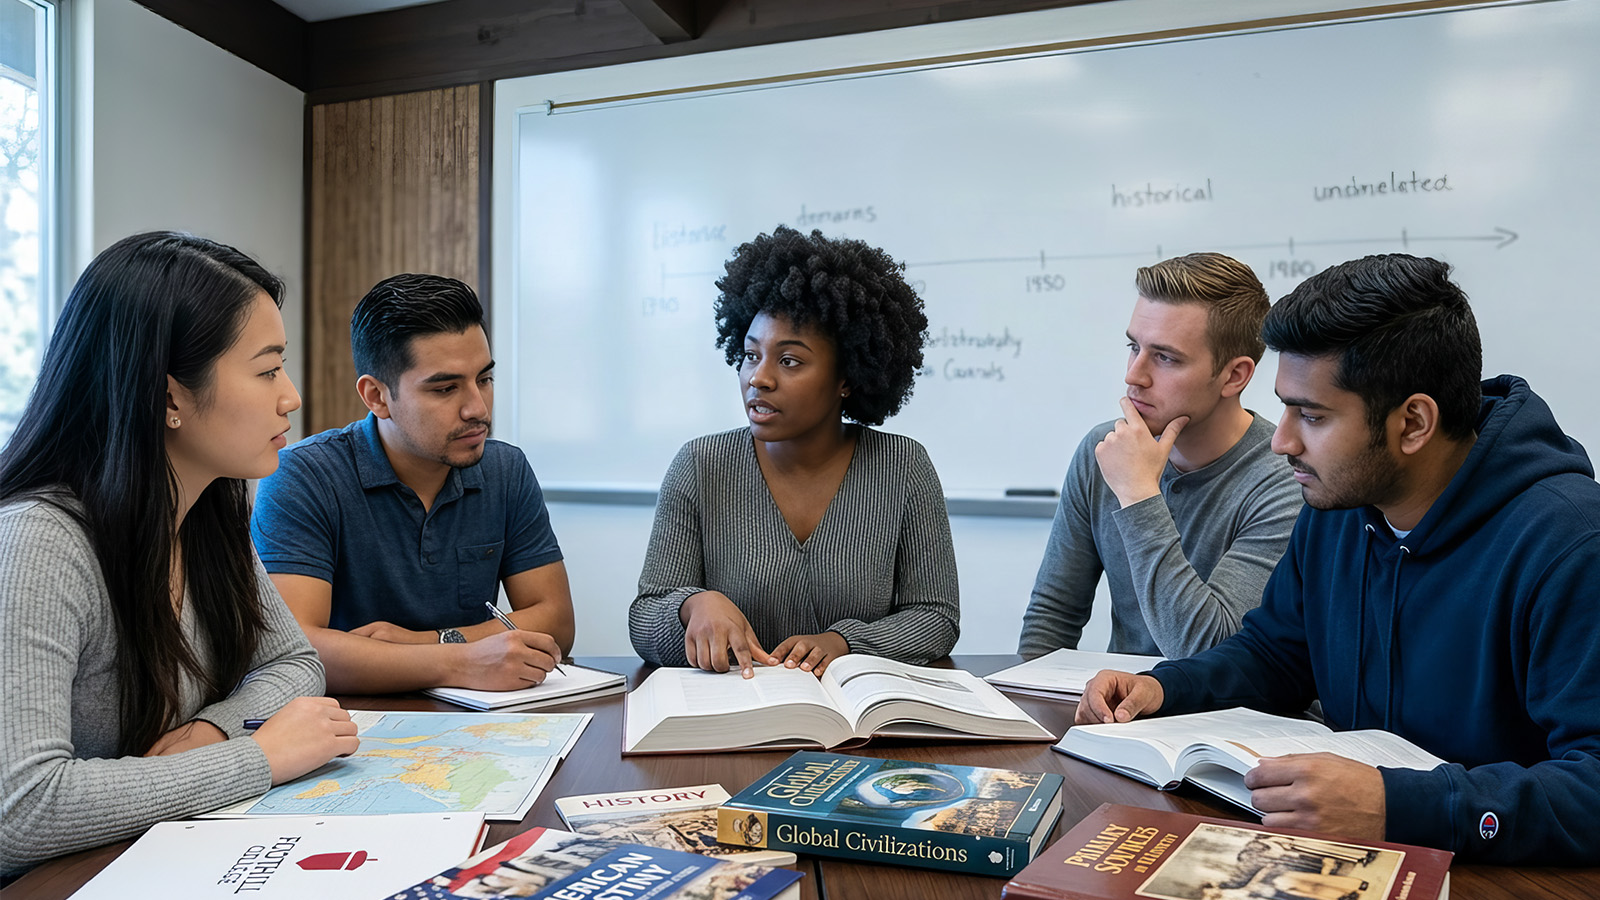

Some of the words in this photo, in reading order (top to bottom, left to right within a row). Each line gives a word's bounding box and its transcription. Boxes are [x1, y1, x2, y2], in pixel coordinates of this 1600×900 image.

[1111, 178, 1213, 207] historical
[582, 789, 706, 809] HISTORY
[776, 824, 840, 848] Global
[845, 832, 968, 863] Civilizations
[543, 852, 653, 900] ERICAN
[593, 864, 672, 900] STINY
